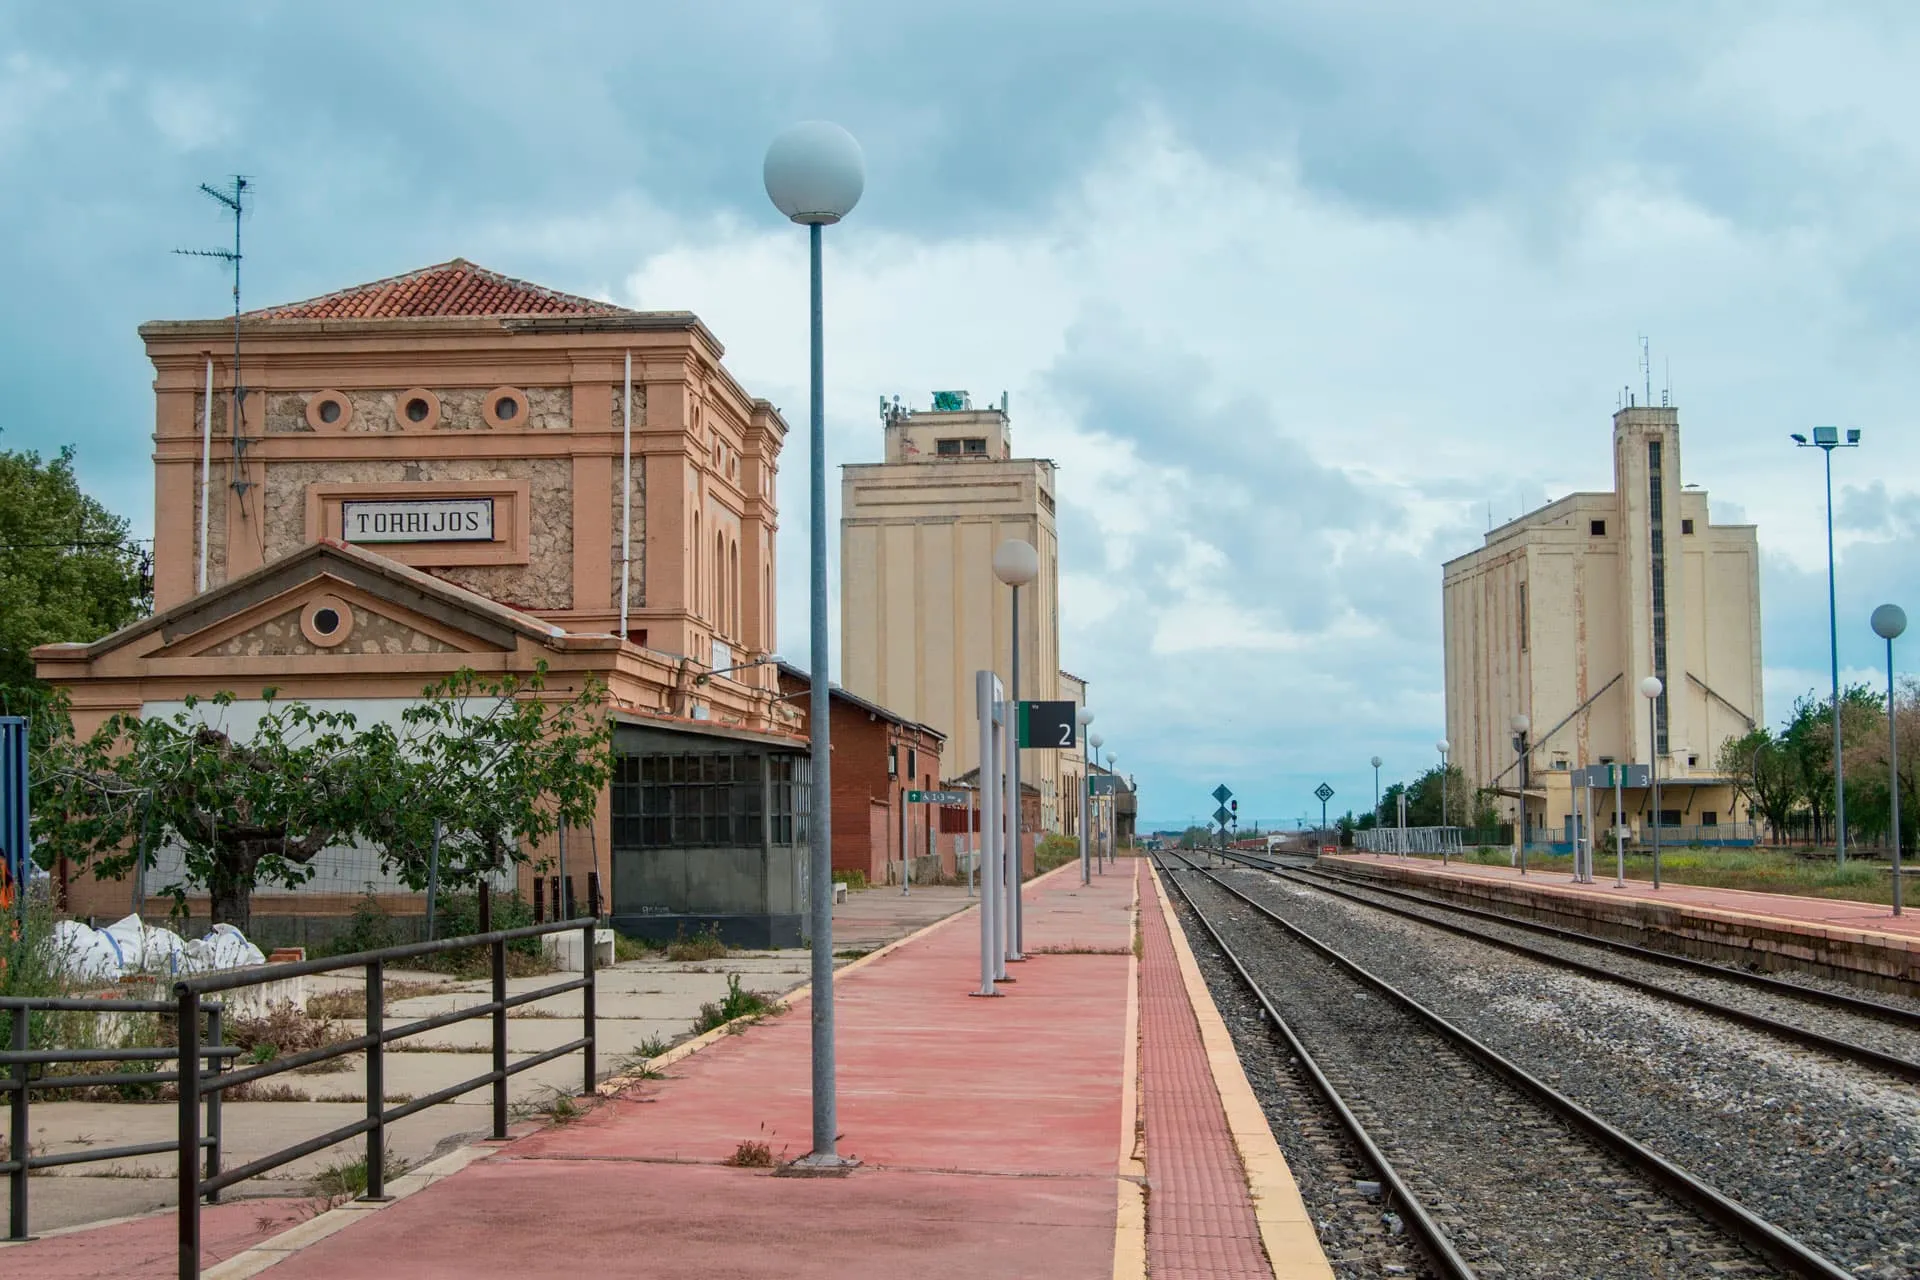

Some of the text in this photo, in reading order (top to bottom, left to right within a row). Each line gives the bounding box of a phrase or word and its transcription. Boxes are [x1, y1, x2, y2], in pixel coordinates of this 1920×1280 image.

[357, 511, 479, 533] TORRIJOS
[1059, 723, 1071, 745] 2
[1588, 775, 1595, 786] 1
[1641, 775, 1648, 786] 3
[1106, 784, 1113, 794] 2
